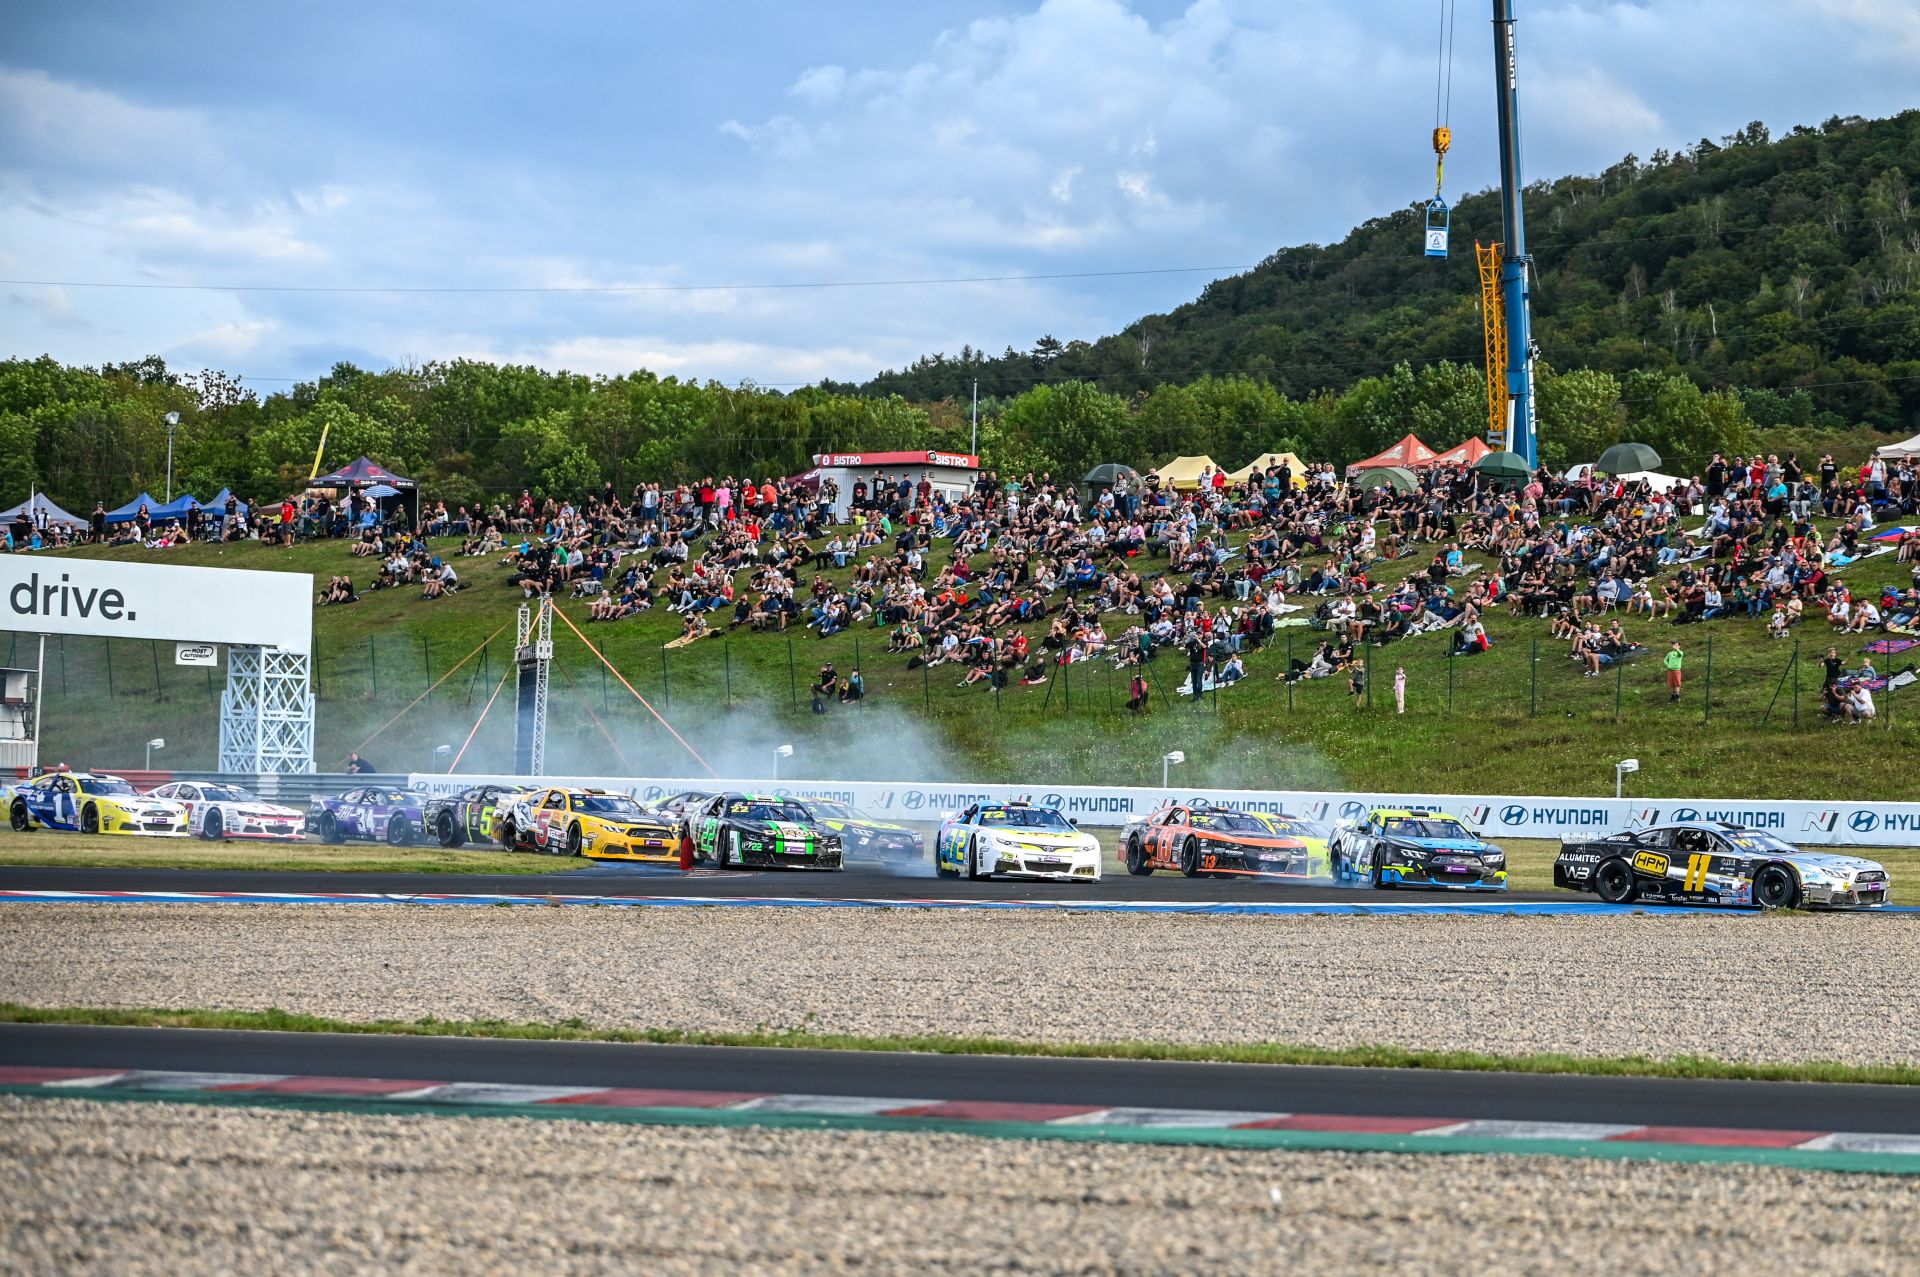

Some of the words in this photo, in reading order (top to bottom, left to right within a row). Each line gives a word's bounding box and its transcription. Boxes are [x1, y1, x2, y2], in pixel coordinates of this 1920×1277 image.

[834, 456, 861, 465] BISTRO
[936, 455, 969, 467] BISTRO
[10, 573, 136, 621] drive.
[53, 793, 66, 823] 1
[730, 805, 749, 813] 22
[1069, 797, 1134, 812] HYUNDAI
[356, 806, 376, 833] 34
[480, 806, 494, 836] 5
[1533, 808, 1608, 825] HYUNDAI
[1706, 811, 1785, 828] HYUNDAI
[536, 811, 551, 847] 5
[752, 842, 762, 851] 22
[949, 828, 967, 860] 72
[1206, 855, 1216, 868] 13
[1354, 839, 1368, 872] 7
[1559, 853, 1601, 863] ALUMITEC
[1637, 855, 1666, 871] HPM
[1684, 854, 1712, 892] 11
